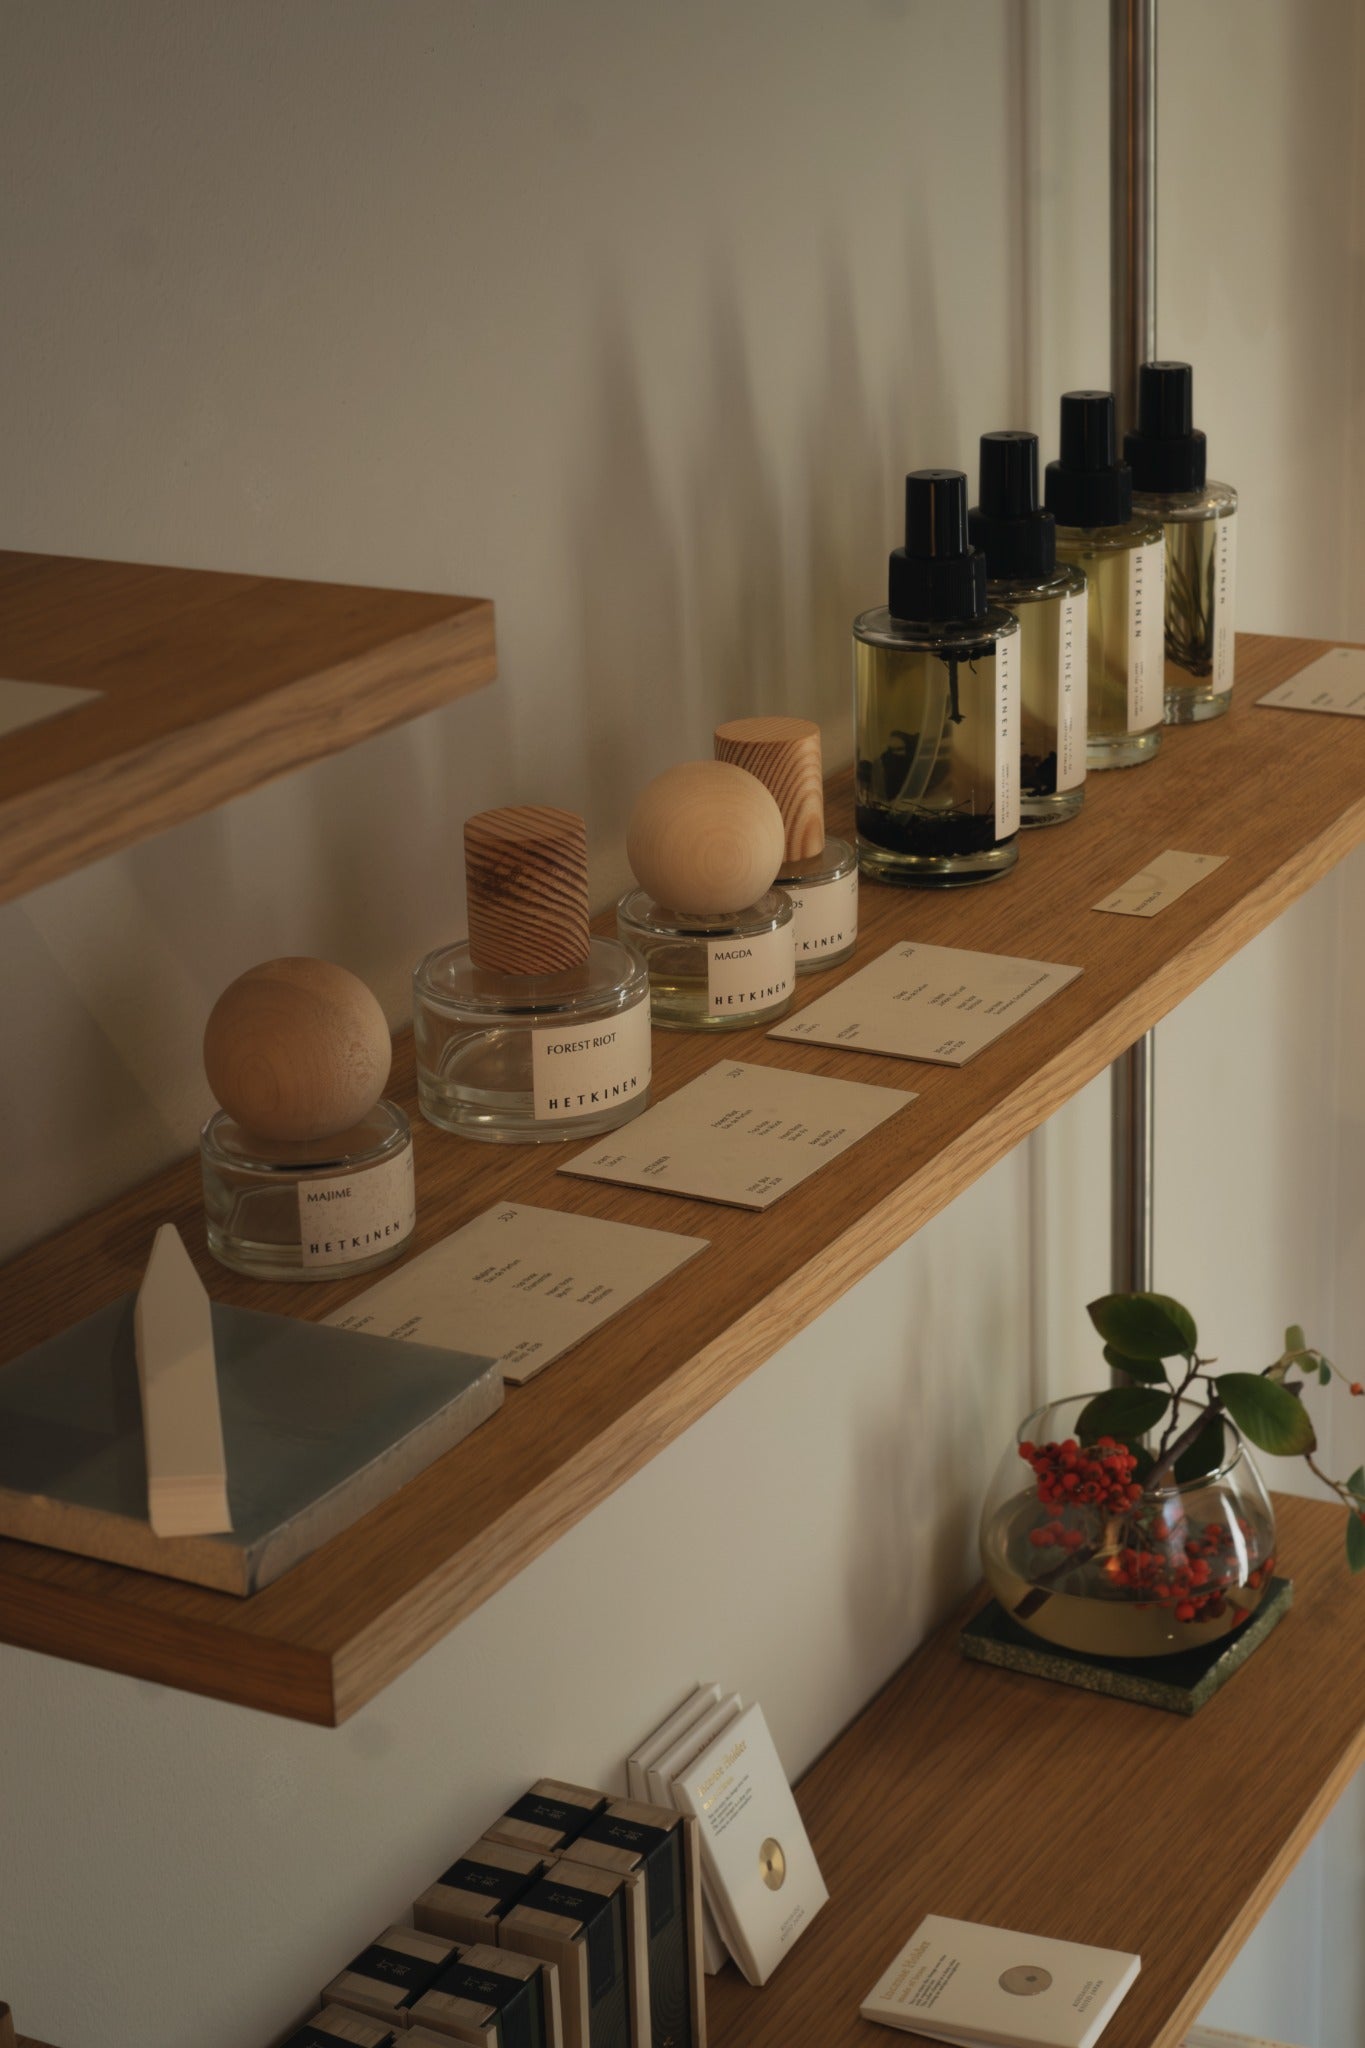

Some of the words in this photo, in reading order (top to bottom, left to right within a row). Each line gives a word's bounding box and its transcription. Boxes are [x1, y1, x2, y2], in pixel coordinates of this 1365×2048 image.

[795, 932, 843, 951] TKINEN
[714, 949, 752, 961] MAGDA
[715, 981, 786, 1005] HETKINEN
[547, 1040, 590, 1055] FOREST
[593, 1032, 616, 1048] RIOT
[549, 1076, 637, 1110] HETKINEN
[307, 1188, 351, 1202] MAJIME
[310, 1221, 400, 1254] HETKINEN
